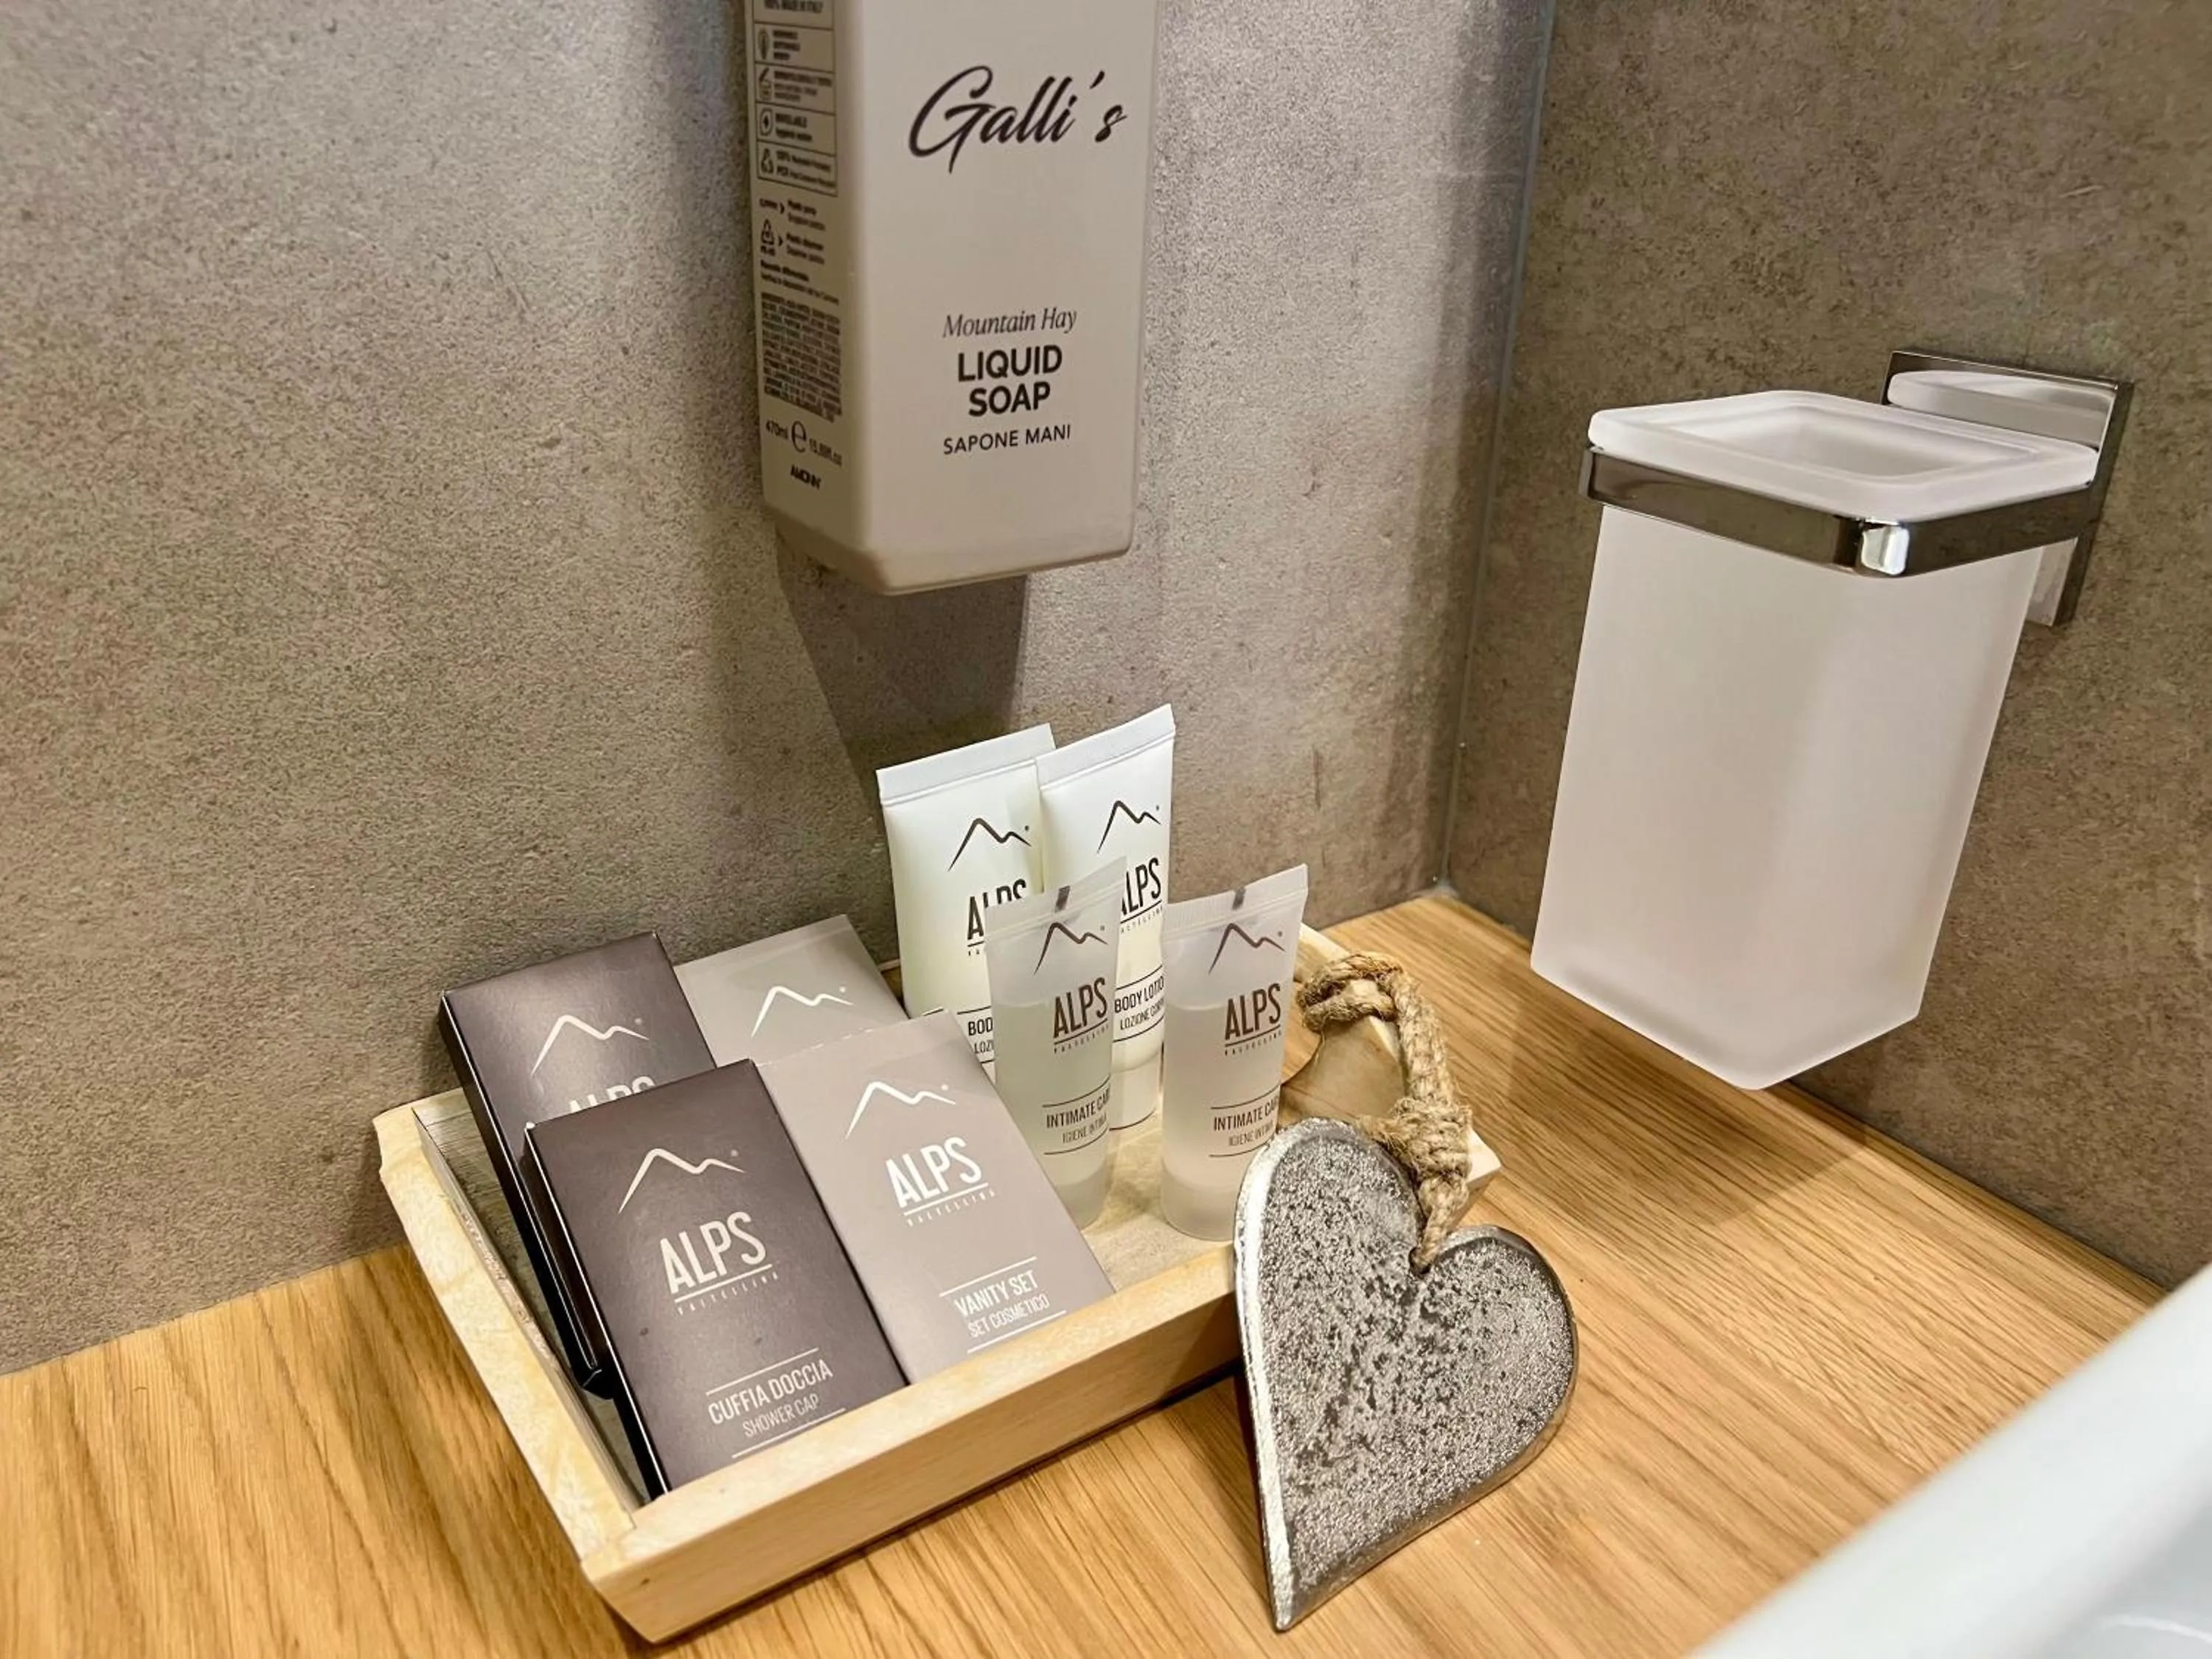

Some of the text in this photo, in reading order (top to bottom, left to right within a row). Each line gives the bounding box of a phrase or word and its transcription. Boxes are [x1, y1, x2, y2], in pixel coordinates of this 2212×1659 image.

[908, 64, 1127, 174] Galli's
[942, 307, 1077, 338] Mountain Hay
[958, 344, 1062, 382] LIQUID
[968, 380, 1051, 417] SOAP
[943, 423, 1071, 455] SAPONE MANI
[1054, 977, 1107, 1038] ALPS
[1114, 975, 1164, 1014] BODY LOTIO
[1225, 983, 1281, 1040] ALPS
[968, 1017, 993, 1036] BOD
[1046, 1100, 1096, 1129] INTIMATE
[1214, 1106, 1263, 1132] INTIMATE
[886, 1137, 981, 1208] ALPS
[660, 1211, 766, 1294] ALPS
[953, 1270, 1038, 1318] VANITY SET
[967, 1293, 1050, 1338] SET COSMETICO
[708, 1359, 833, 1425] CUFFIA DOCCIA
[742, 1393, 819, 1437] SHOWER CAP
